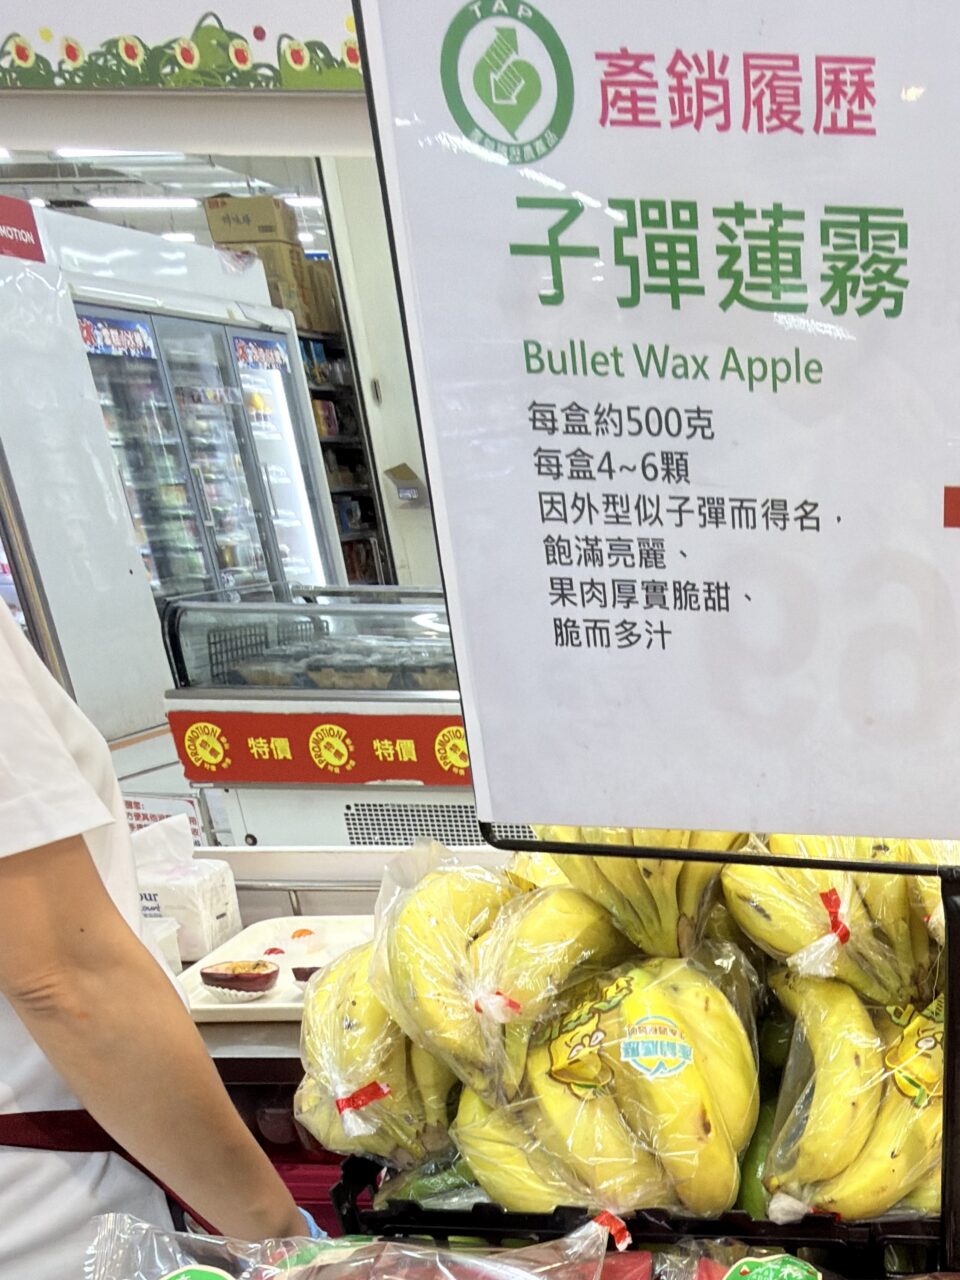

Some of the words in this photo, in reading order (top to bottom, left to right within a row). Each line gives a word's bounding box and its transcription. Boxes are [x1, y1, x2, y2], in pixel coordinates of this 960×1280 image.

[469, 0, 533, 19] TAP
[594, 47, 877, 138] 產銷履歷
[509, 196, 910, 320] 子彈蓮霧
[523, 338, 625, 380] Bullet
[633, 343, 711, 382] Wax
[720, 347, 824, 393] Apple
[528, 400, 715, 441] 每盒約500克
[532, 447, 691, 487] 每盒4~6顆
[553, 616, 674, 652] 脆而多汁
[187, 725, 218, 763] PROMOTION
[248, 737, 292, 760] 特價
[311, 727, 343, 765] PROMOTION
[372, 739, 417, 762] 特價
[438, 729, 465, 768] PROMOTIO
